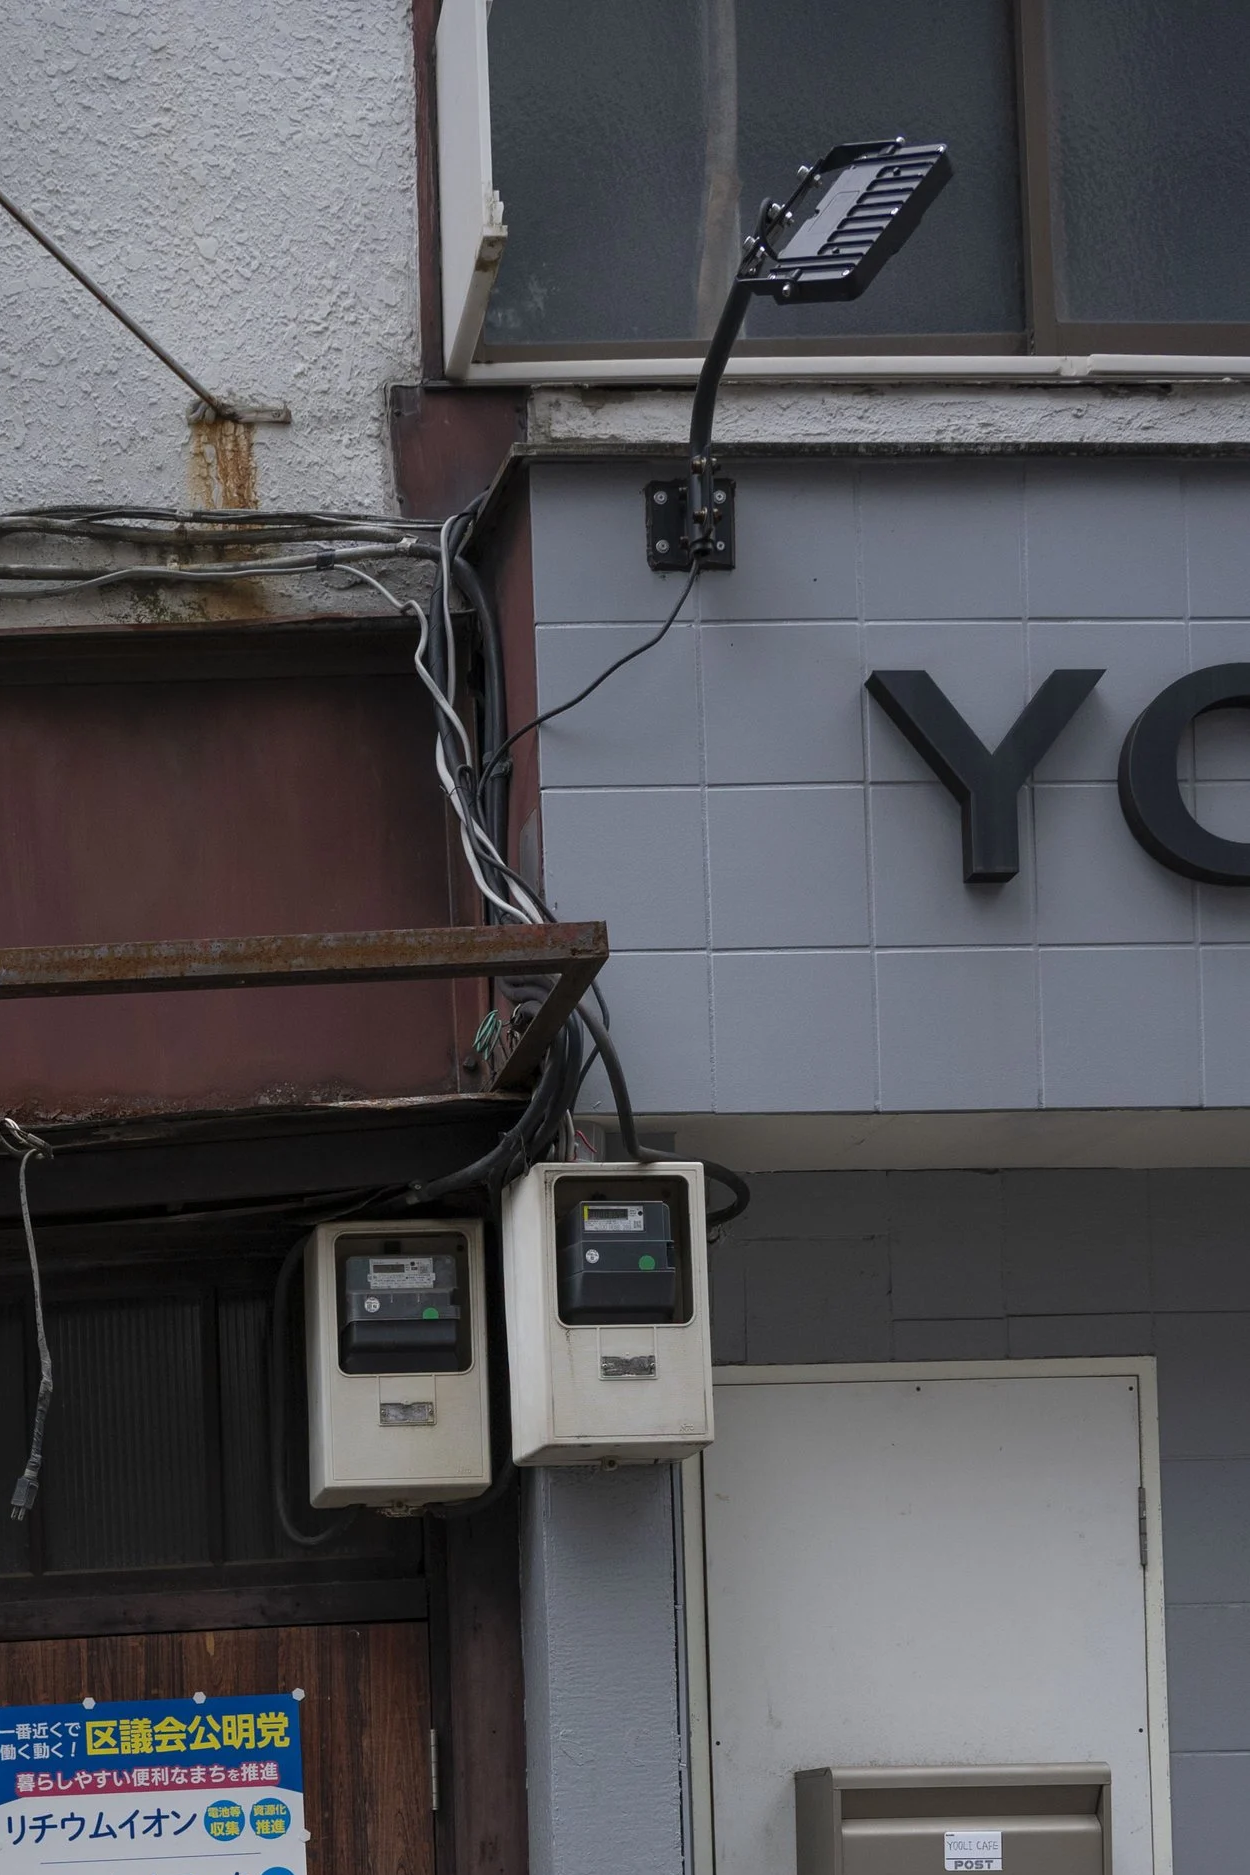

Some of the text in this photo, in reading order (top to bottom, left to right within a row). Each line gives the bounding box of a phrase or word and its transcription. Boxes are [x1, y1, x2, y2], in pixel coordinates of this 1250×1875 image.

[0, 1722, 81, 1740] 一番近くで
[86, 1712, 290, 1755] 区議会公明党
[0, 1741, 76, 1761] 働く動く！
[17, 1762, 278, 1792] 暮らしやすい便利なまちを推進
[253, 1804, 287, 1816] 資源化
[7, 1808, 197, 1845] リチウムイオン
[210, 1821, 240, 1836] 収集
[256, 1819, 286, 1835] 推進
[954, 1859, 994, 1870] POST
